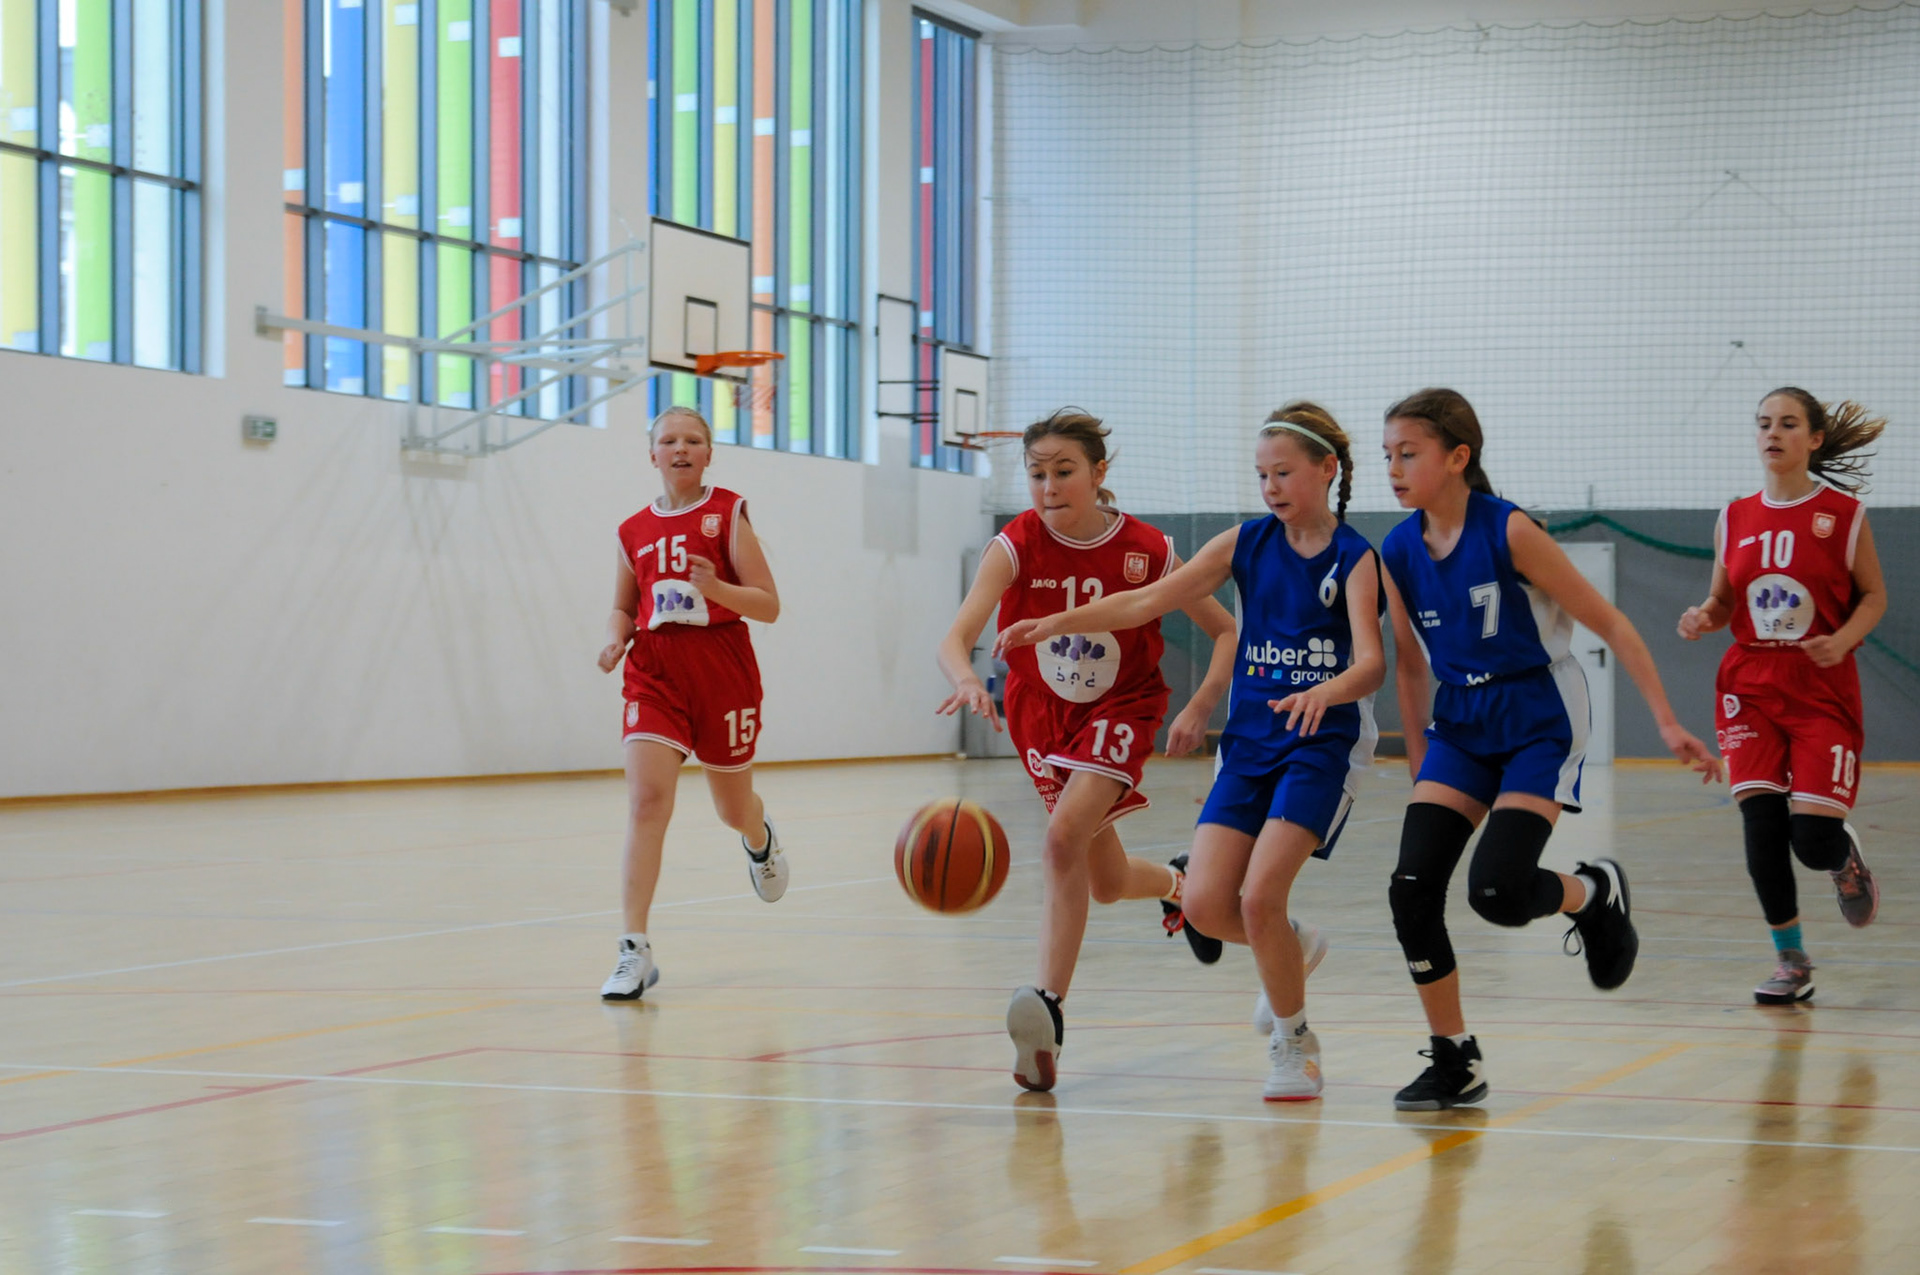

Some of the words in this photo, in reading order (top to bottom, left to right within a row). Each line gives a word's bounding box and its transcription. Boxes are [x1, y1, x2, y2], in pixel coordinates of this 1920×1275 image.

[655, 534, 687, 574] 15
[1758, 530, 1795, 569] 10
[1030, 578, 1057, 589] JAKO
[1318, 562, 1338, 608] 6
[1469, 581, 1501, 639] 7
[724, 708, 756, 747] 15
[1091, 719, 1134, 764] 13
[1830, 744, 1856, 789] 10
